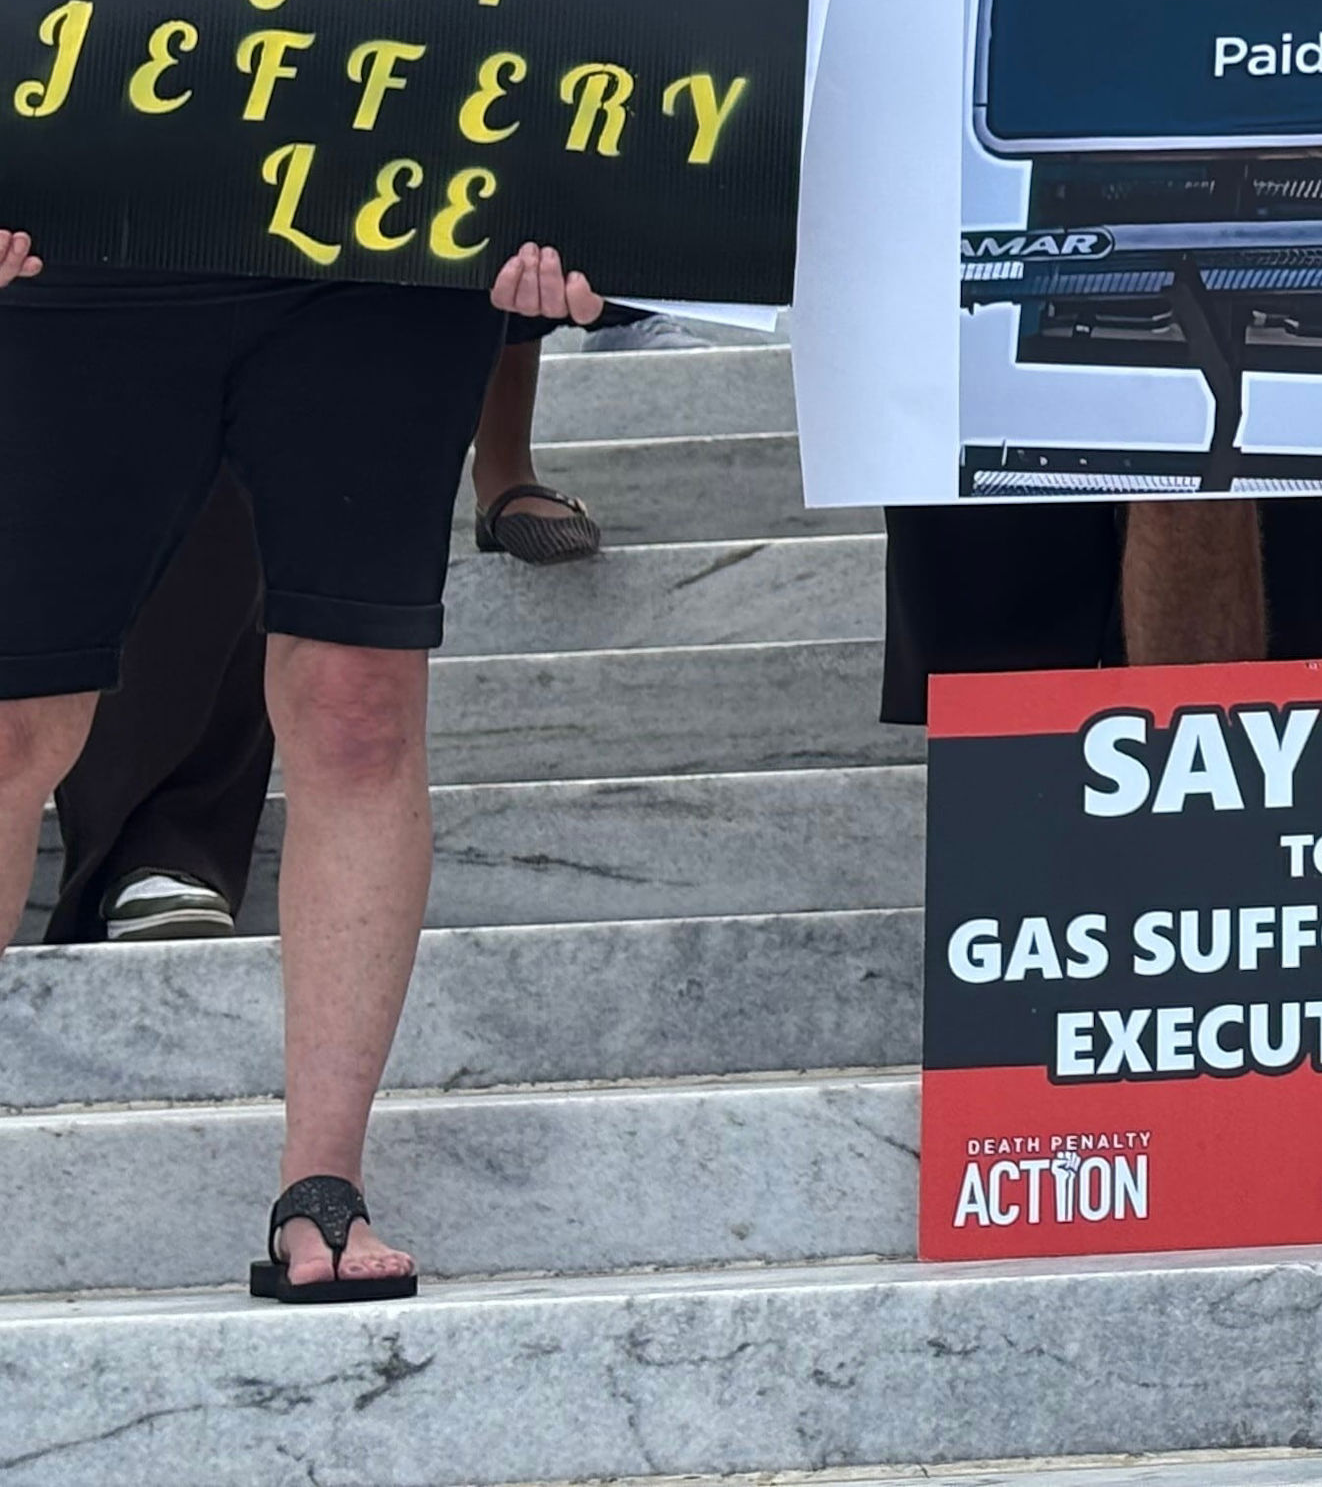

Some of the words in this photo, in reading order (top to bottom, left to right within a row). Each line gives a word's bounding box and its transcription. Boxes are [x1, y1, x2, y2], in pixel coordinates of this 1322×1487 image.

[261, 142, 497, 266] LEE
[1082, 709, 1321, 817] SAY
[947, 916, 1109, 984] GAS
[968, 1135, 1041, 1155] DEATH
[1051, 1131, 1152, 1151] PENALTY
